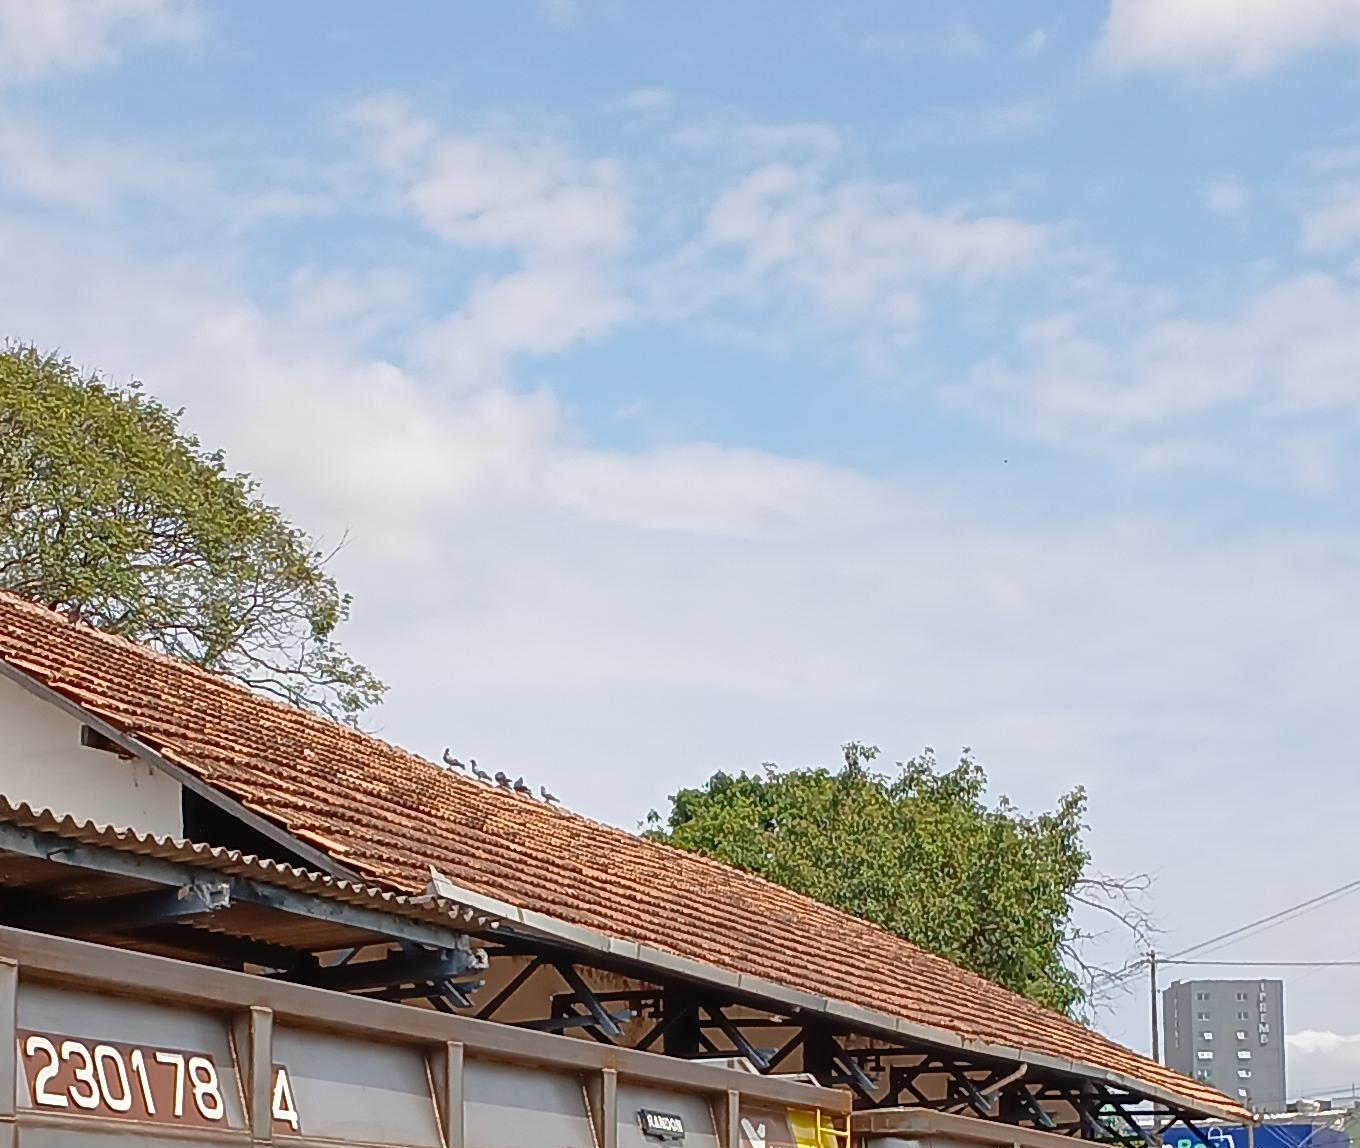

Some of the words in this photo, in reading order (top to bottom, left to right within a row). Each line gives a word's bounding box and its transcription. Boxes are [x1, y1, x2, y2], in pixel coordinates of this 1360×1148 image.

[26, 1036, 224, 1121] 230178
[272, 1068, 299, 1130] 4
[646, 1114, 683, 1133] RANDON
